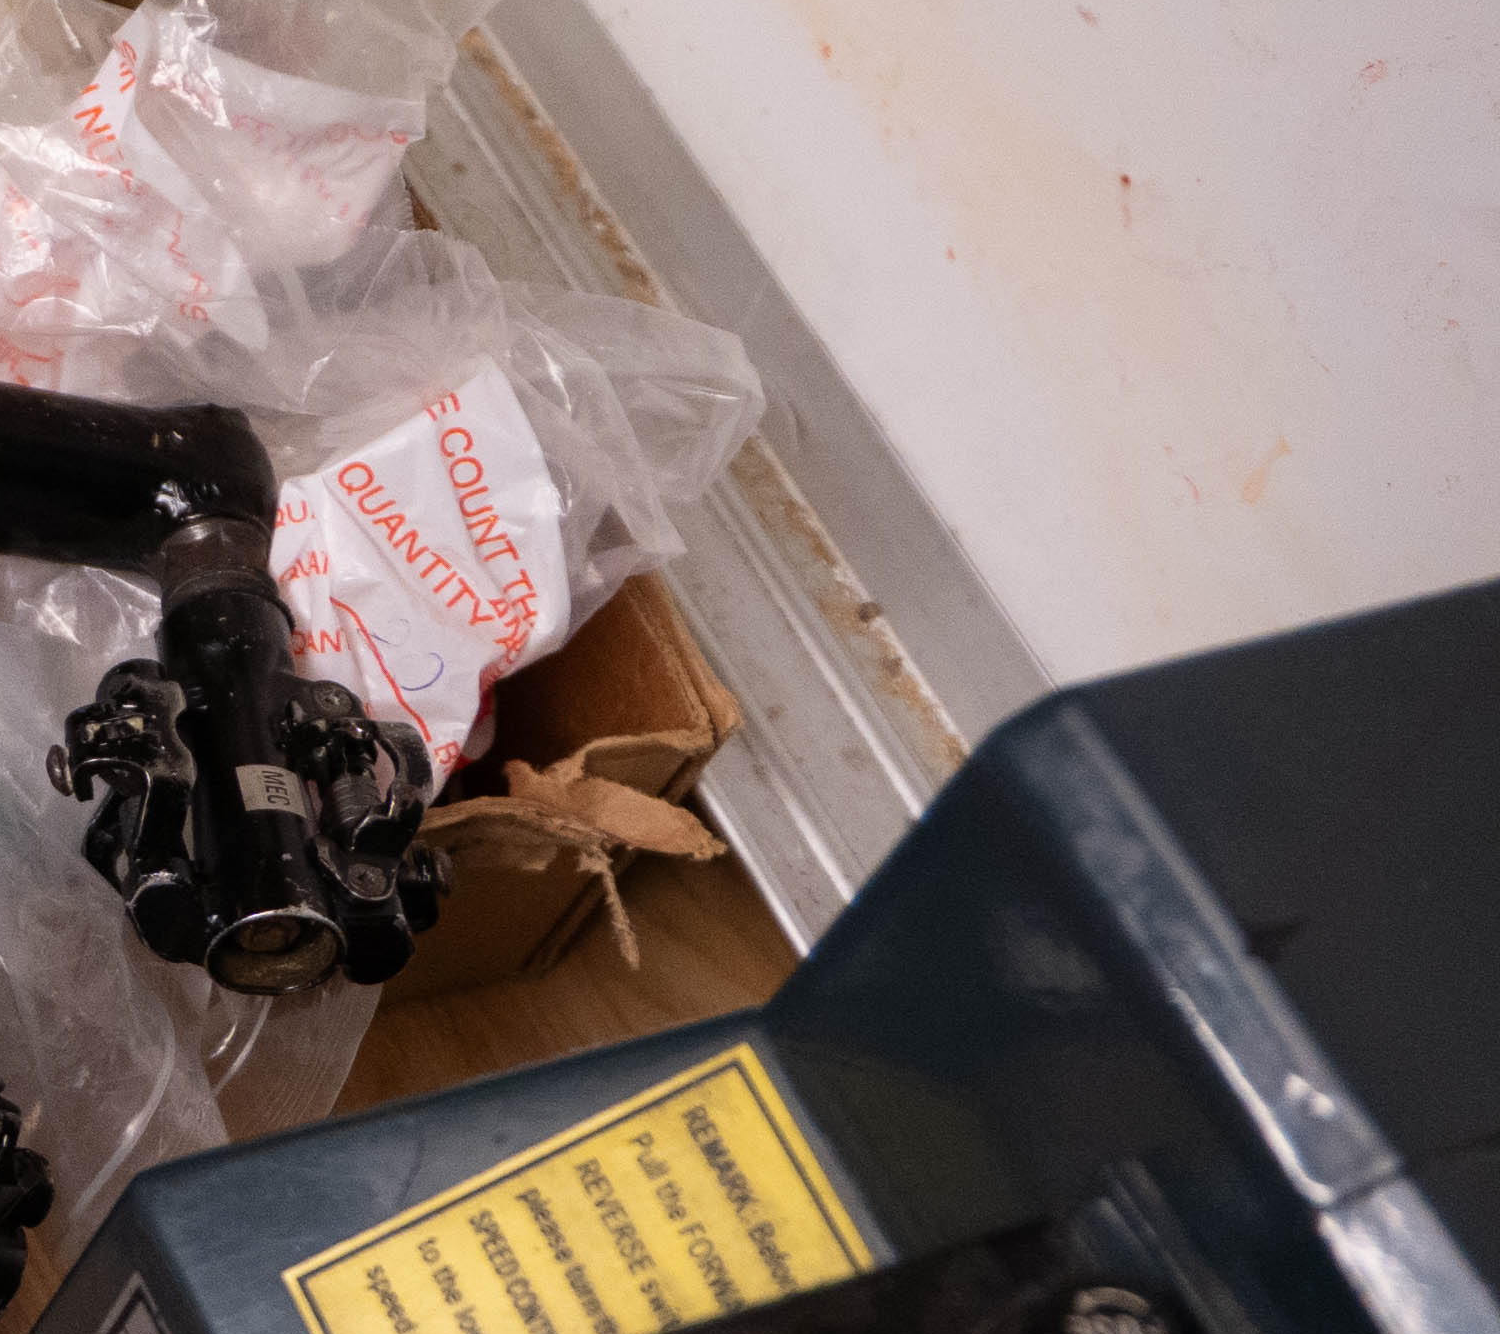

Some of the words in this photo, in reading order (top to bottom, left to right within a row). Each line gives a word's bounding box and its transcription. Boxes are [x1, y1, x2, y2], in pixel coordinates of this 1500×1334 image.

[439, 427, 520, 562] COUNT
[337, 461, 494, 626] QUANTITY
[261, 770, 291, 806] MEC
[515, 1182, 580, 1268] please
[571, 1154, 656, 1279] REVERSE
[653, 1177, 695, 1225] the
[415, 1234, 447, 1267] to
[466, 1207, 524, 1281] SPEED
[430, 1263, 469, 1308] the
